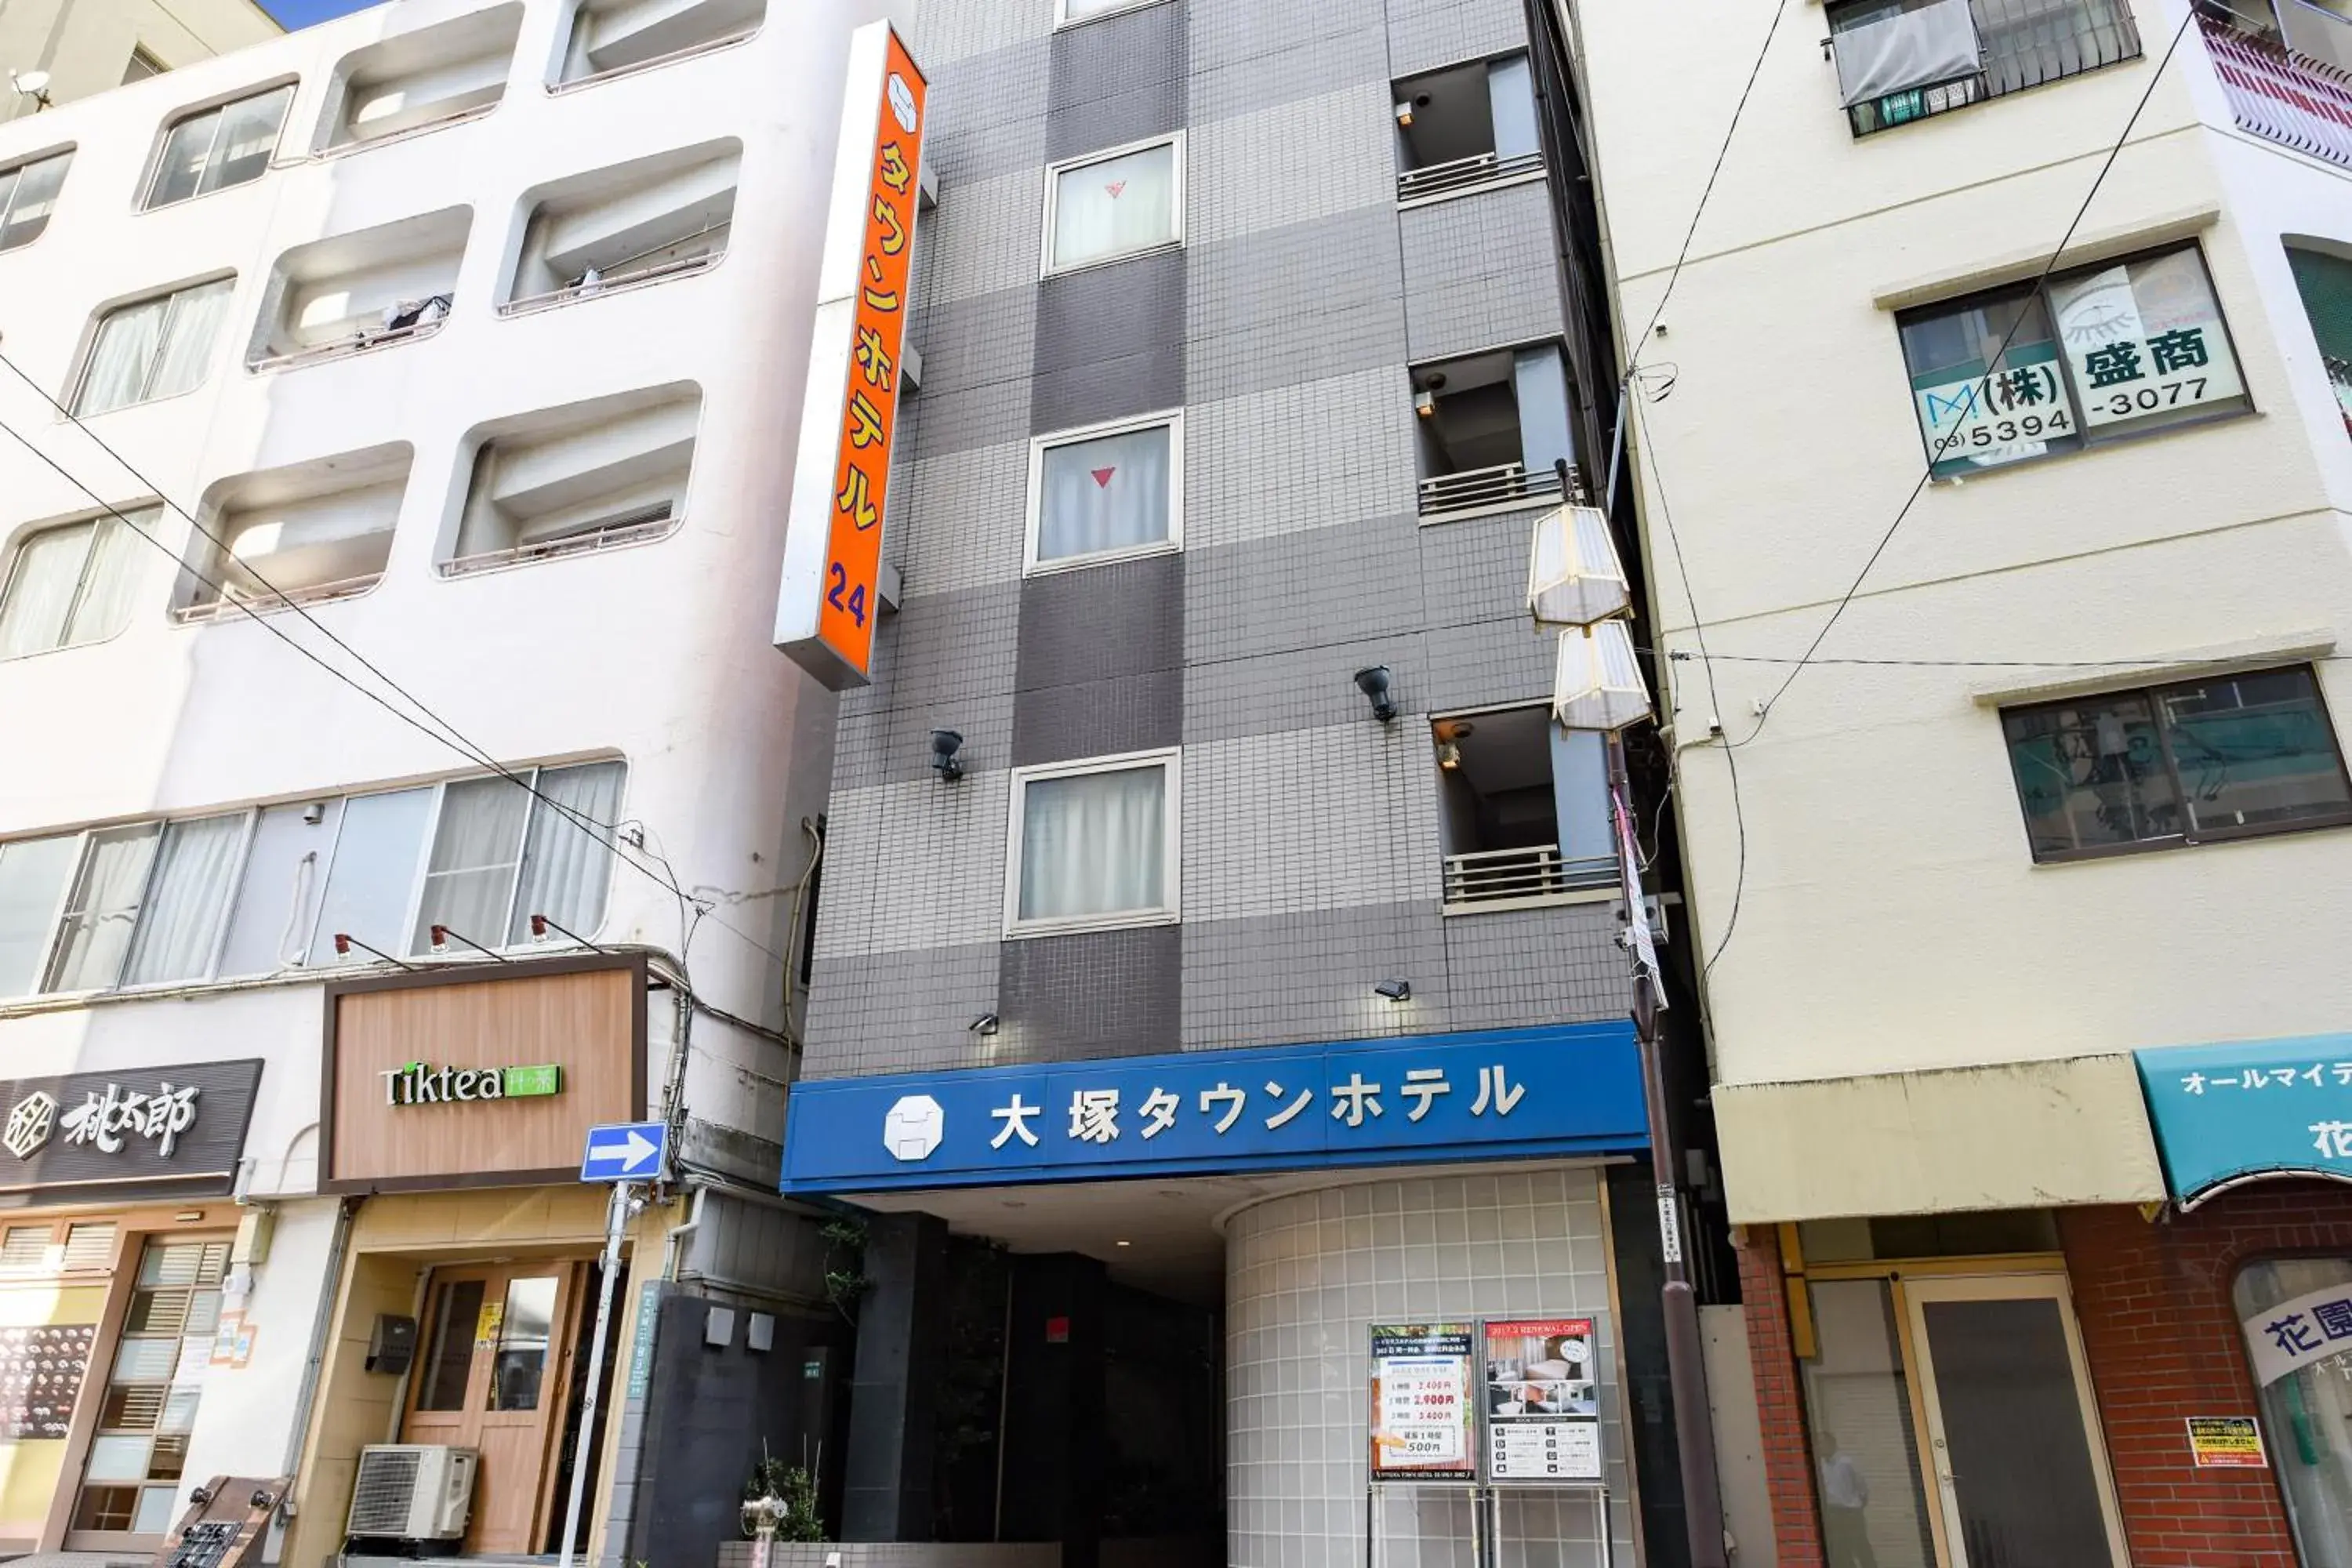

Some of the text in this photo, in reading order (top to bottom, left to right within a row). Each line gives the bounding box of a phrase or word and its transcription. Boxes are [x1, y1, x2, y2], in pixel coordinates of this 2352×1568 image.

[837, 140, 911, 532] タウンホテル
[2085, 327, 2209, 390] 盛商
[827, 561, 866, 629] 24
[376, 1061, 503, 1105] Tiktea
[990, 1065, 1526, 1149] 大塚タウンホテル
[60, 1082, 200, 1156] 桃太郎
[1408, 1442, 1440, 1452] 500円
